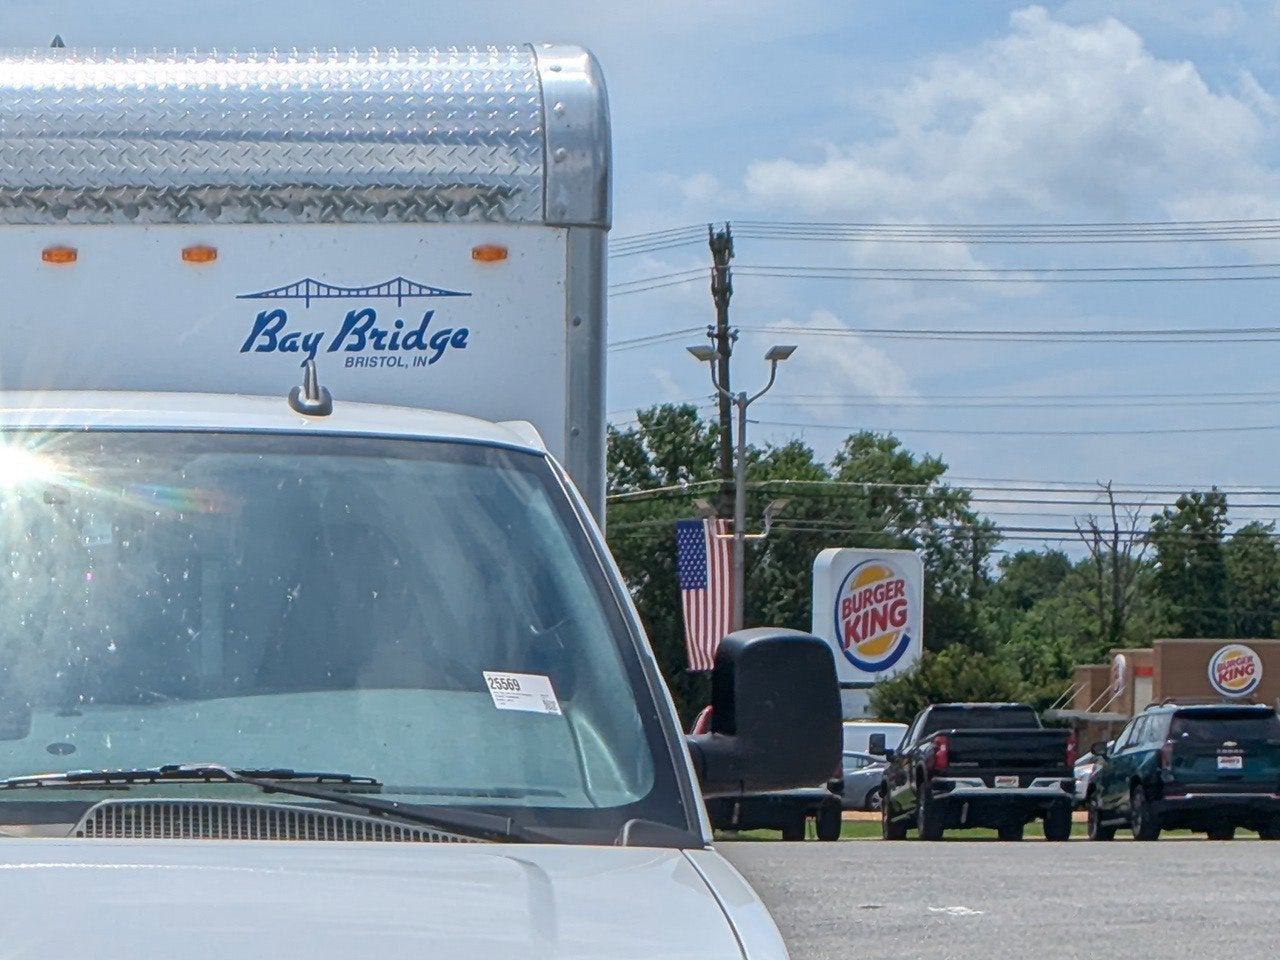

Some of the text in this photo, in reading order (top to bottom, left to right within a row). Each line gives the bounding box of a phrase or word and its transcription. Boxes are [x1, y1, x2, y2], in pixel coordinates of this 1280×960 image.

[240, 308, 469, 367] Bay Bridge
[345, 356, 428, 369] BRISTOL, IN
[842, 579, 905, 620] BURGER
[843, 598, 908, 648] KING
[488, 677, 521, 691] 25569
[1218, 663, 1255, 684] KING
